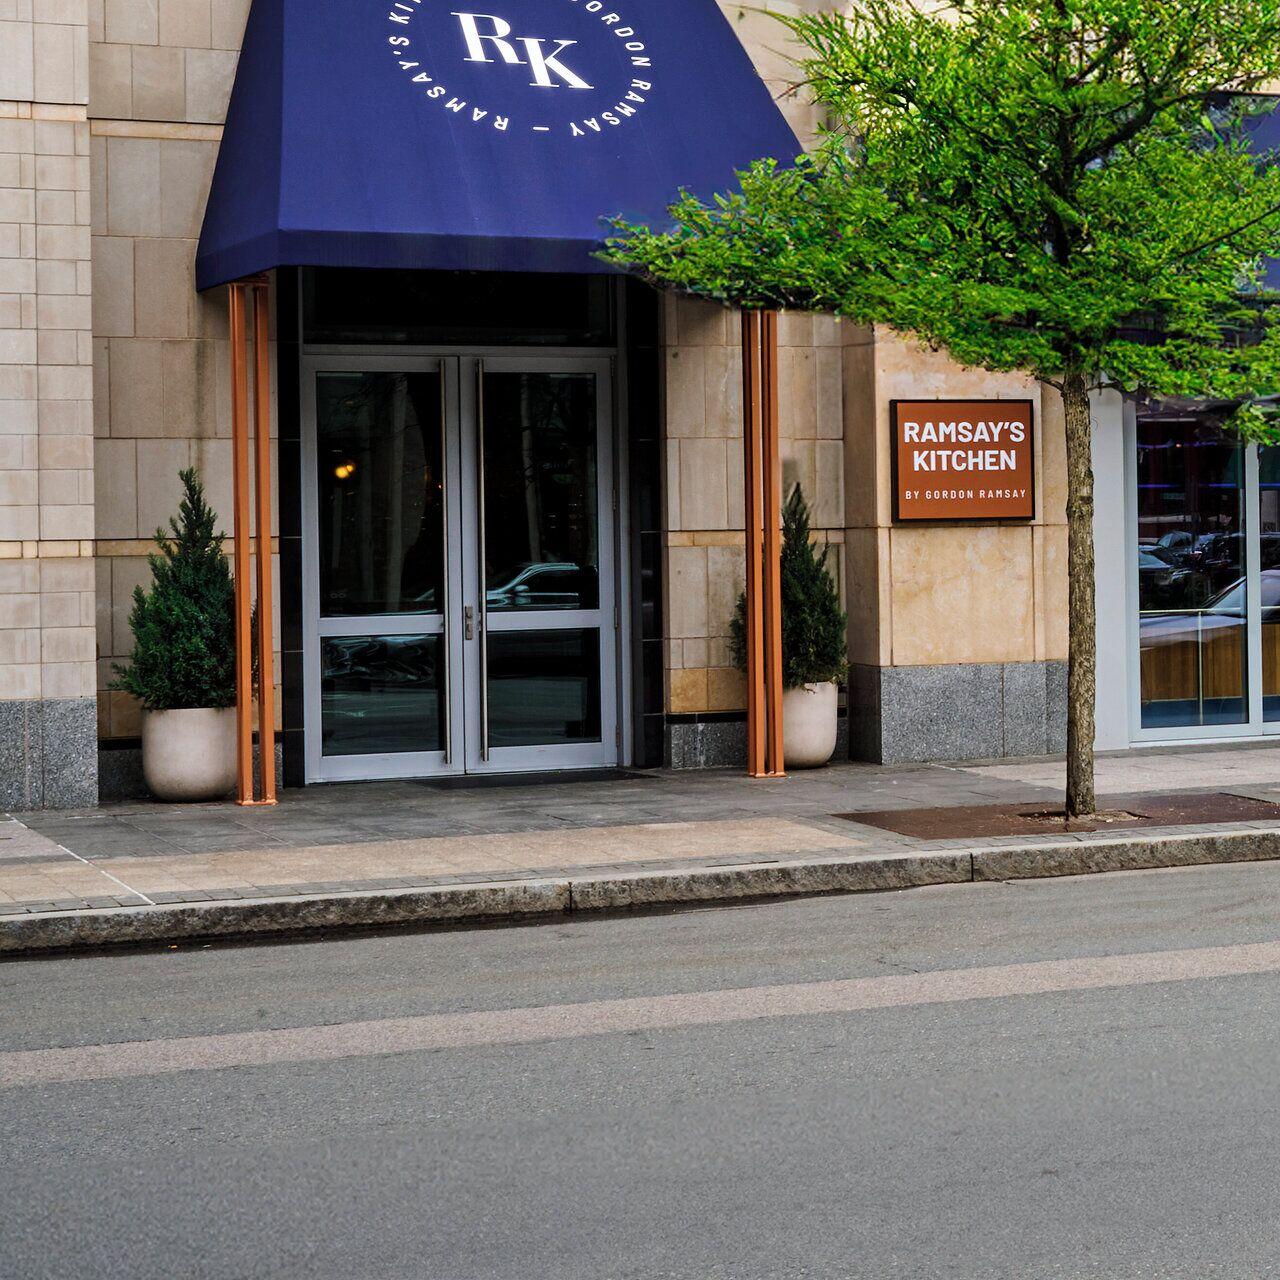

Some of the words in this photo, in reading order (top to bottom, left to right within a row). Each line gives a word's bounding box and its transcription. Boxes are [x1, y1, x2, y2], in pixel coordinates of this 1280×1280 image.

[450, 11, 595, 90] RK
[388, 35, 509, 131] RAMSAY'S
[569, 77, 652, 137] RAMSAY
[903, 421, 1026, 443] RAMSAY'S
[913, 449, 1017, 472] KITCHEN
[905, 490, 920, 500] BY
[925, 489, 974, 500] GORDON
[979, 489, 1026, 499] RAMSAY
